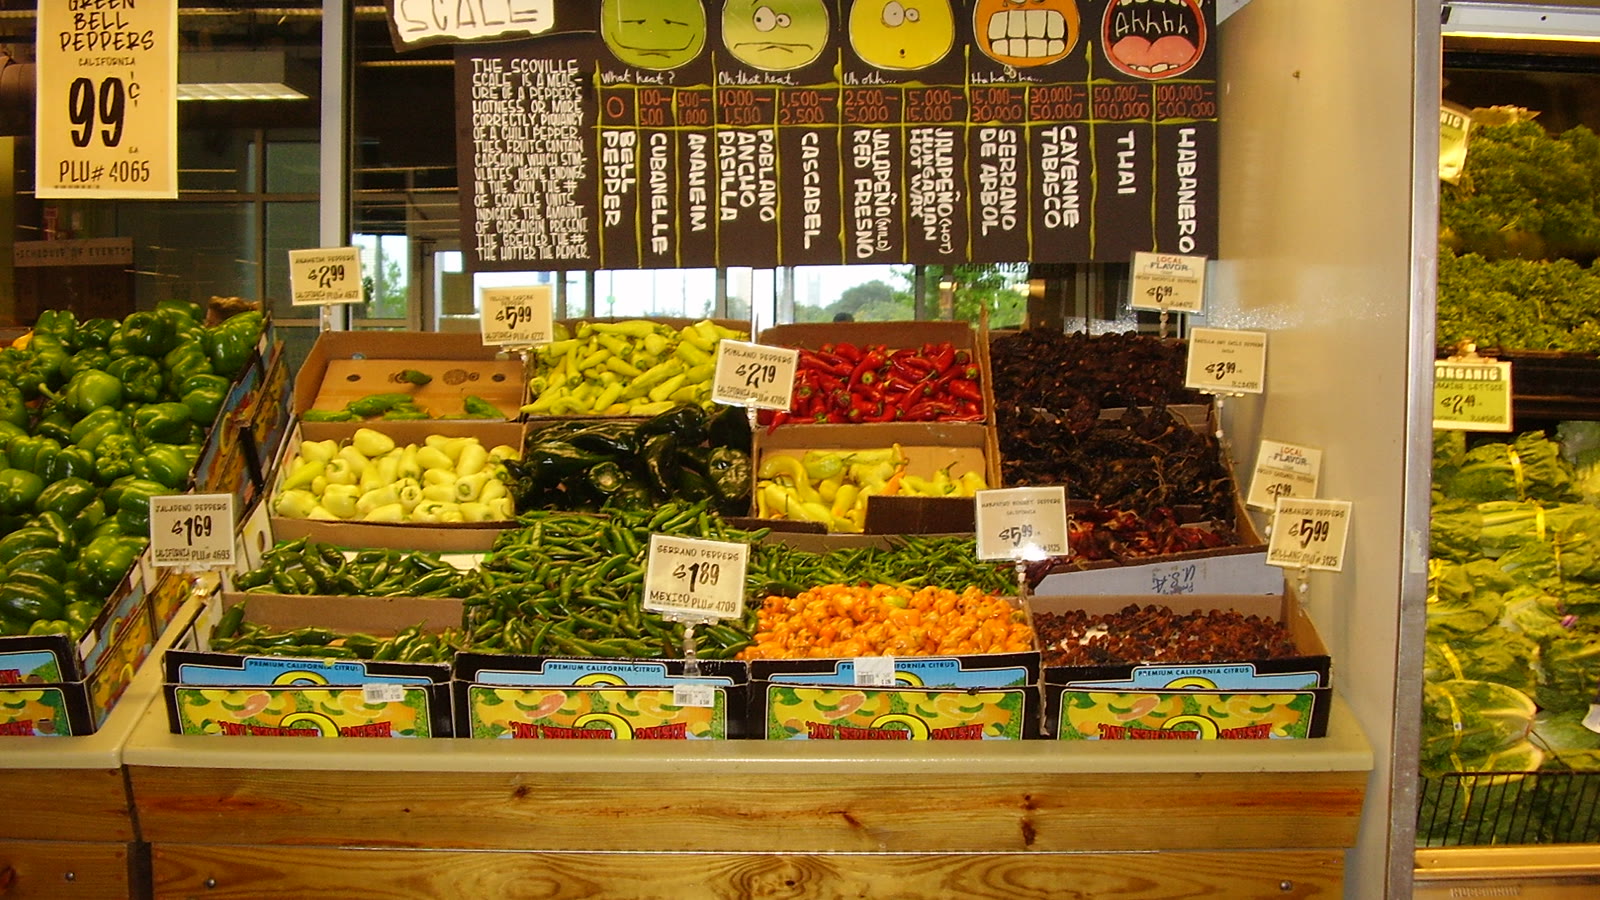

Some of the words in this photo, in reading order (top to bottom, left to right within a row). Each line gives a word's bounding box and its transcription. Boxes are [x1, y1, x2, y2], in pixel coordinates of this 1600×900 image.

[74, 11, 129, 31] BELL
[60, 30, 154, 52] PEPPERS
[79, 57, 136, 67] CALIFORNIA
[471, 58, 503, 73] THE
[511, 58, 579, 74] SCOVILLE
[472, 72, 512, 87] SCALE
[522, 72, 532, 87] IS
[536, 73, 545, 87] A
[601, 70, 631, 85] What
[843, 73, 859, 86] Uh
[472, 86, 499, 99] URE
[502, 86, 513, 99] OF
[517, 86, 525, 100] A
[472, 99, 525, 114] HOTNESS
[552, 100, 582, 114] MORE
[640, 108, 663, 126] 500
[473, 126, 486, 140] OF
[489, 126, 498, 140] A
[979, 128, 997, 158] DE
[506, 139, 543, 153] FRUITS
[853, 129, 872, 169] RED
[909, 129, 922, 169] HOT
[60, 160, 104, 182] PLU#
[109, 160, 151, 182] 4065
[619, 131, 636, 194] BELL
[737, 132, 756, 208] ANCHO
[1117, 129, 1137, 194] THAI
[474, 180, 485, 194] IN
[488, 179, 508, 194] THE
[541, 179, 561, 193] THE
[602, 131, 621, 228] PEPPER
[688, 133, 707, 232] ANAHEIM
[718, 131, 738, 221] PASILLA
[757, 129, 776, 223] POBLANO
[920, 128, 938, 241] HUNGARIAN
[998, 128, 1018, 231] SERRANO
[1041, 126, 1061, 229] TABASCO
[1060, 125, 1080, 229] CAYENNE
[474, 194, 489, 208] OF
[495, 193, 541, 208] SCOVILLE
[650, 132, 668, 256] CUBANELLE
[801, 131, 822, 250] CASCABEL
[909, 174, 924, 218] WAX
[978, 163, 999, 237] ARBOL
[1176, 127, 1198, 254] HABANERO
[521, 206, 542, 220] THE
[854, 178, 875, 259] FRESNO
[475, 220, 490, 234] OF
[476, 233, 498, 247] THE
[475, 246, 497, 261] THE
[1150, 262, 1189, 272] FLAVOR
[1436, 366, 1498, 381] ORGANIC
[1273, 453, 1307, 466] FLAVOR
[657, 545, 697, 557] SERRANO
[701, 549, 739, 561] PEPPERS
[650, 590, 690, 604] MEXICO
[715, 600, 736, 612] 4709
[286, 662, 332, 670] CALIFORNIA
